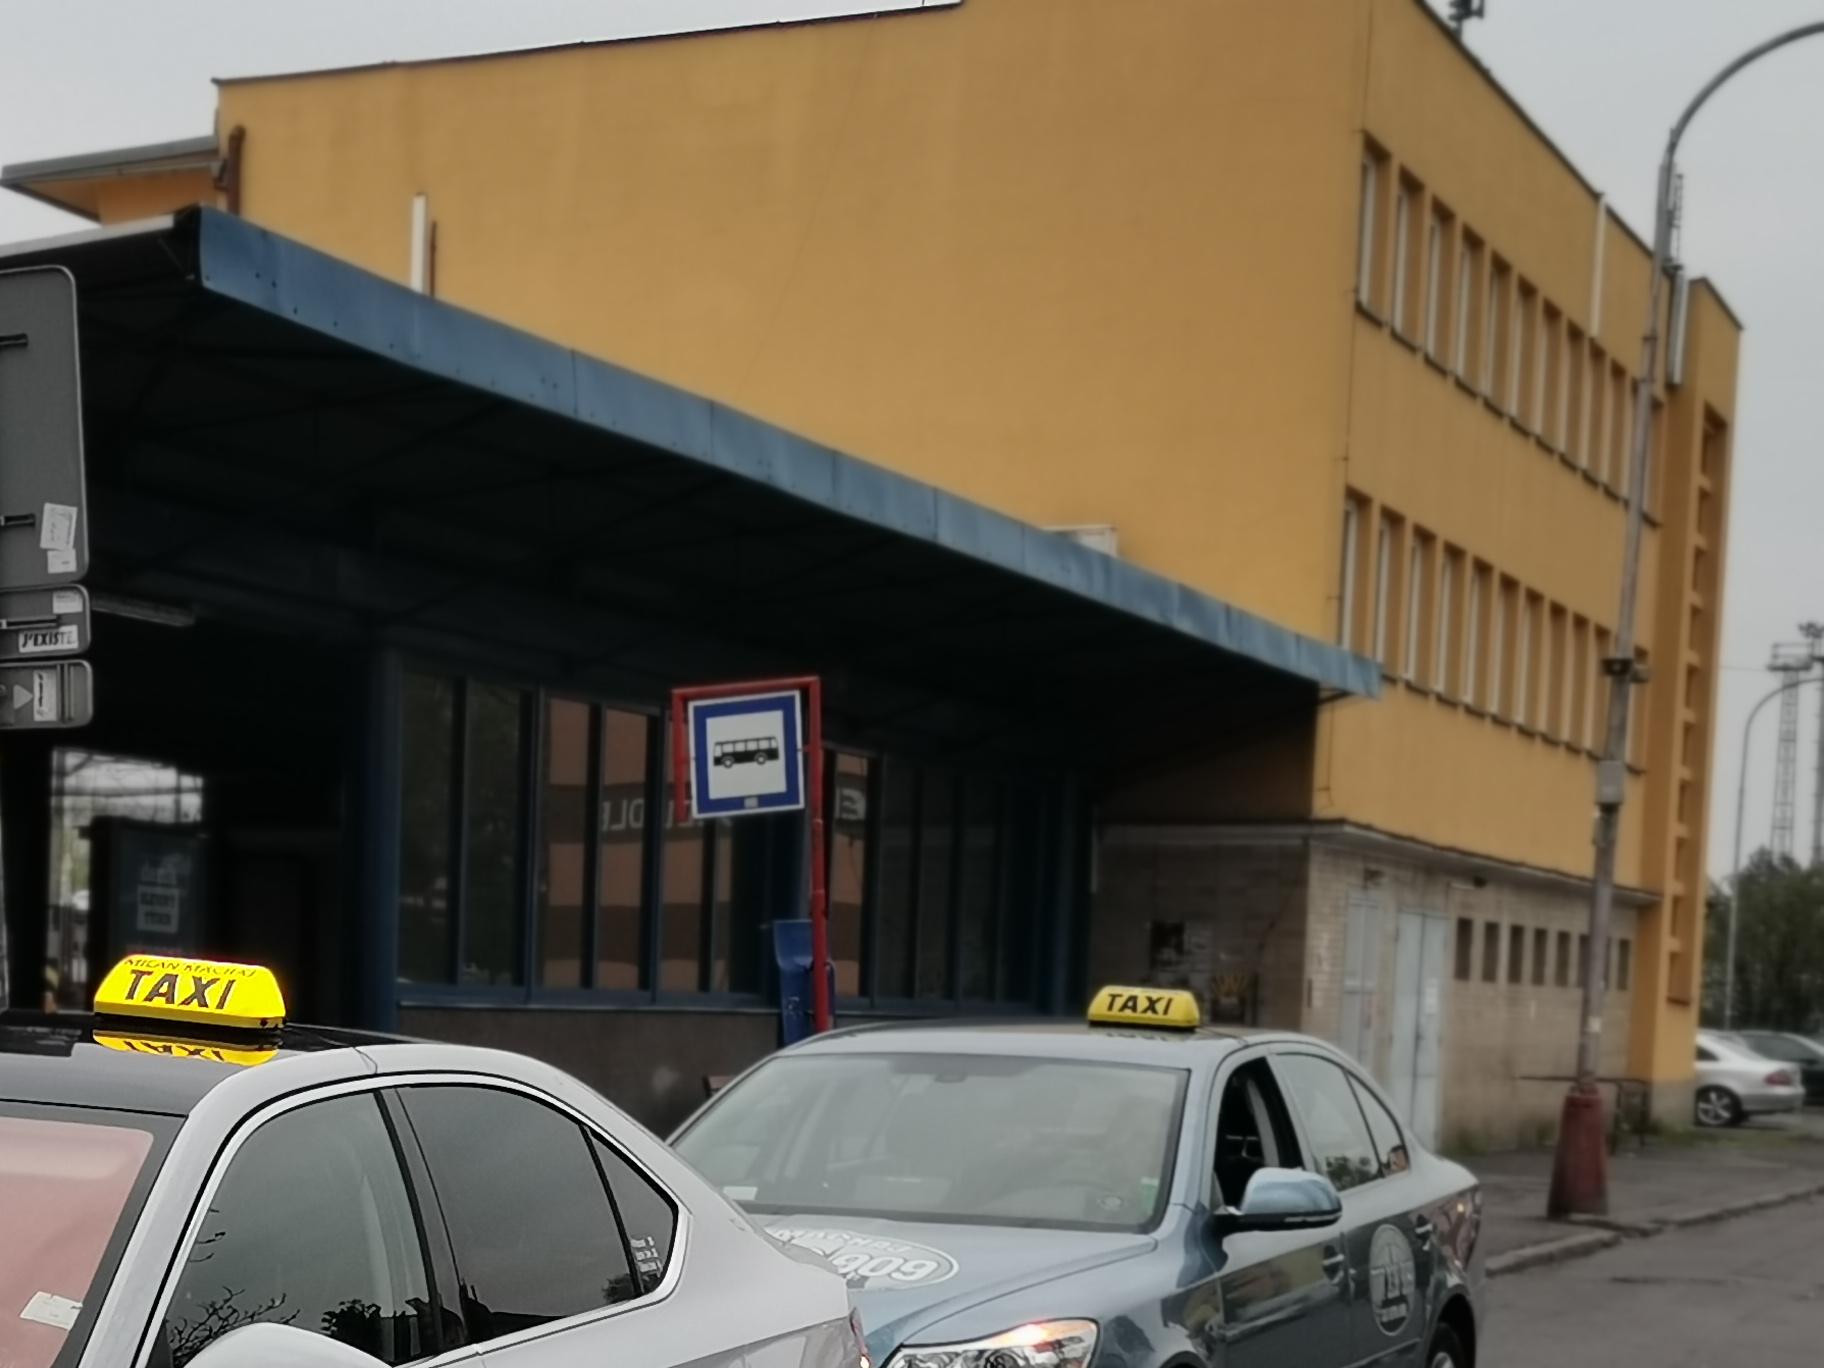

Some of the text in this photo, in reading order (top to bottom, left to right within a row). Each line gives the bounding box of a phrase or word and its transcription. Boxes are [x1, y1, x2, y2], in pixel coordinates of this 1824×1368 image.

[125, 969, 237, 1010] TAXI
[1107, 993, 1174, 1016] TAXI
[831, 1253, 939, 1281] 909
